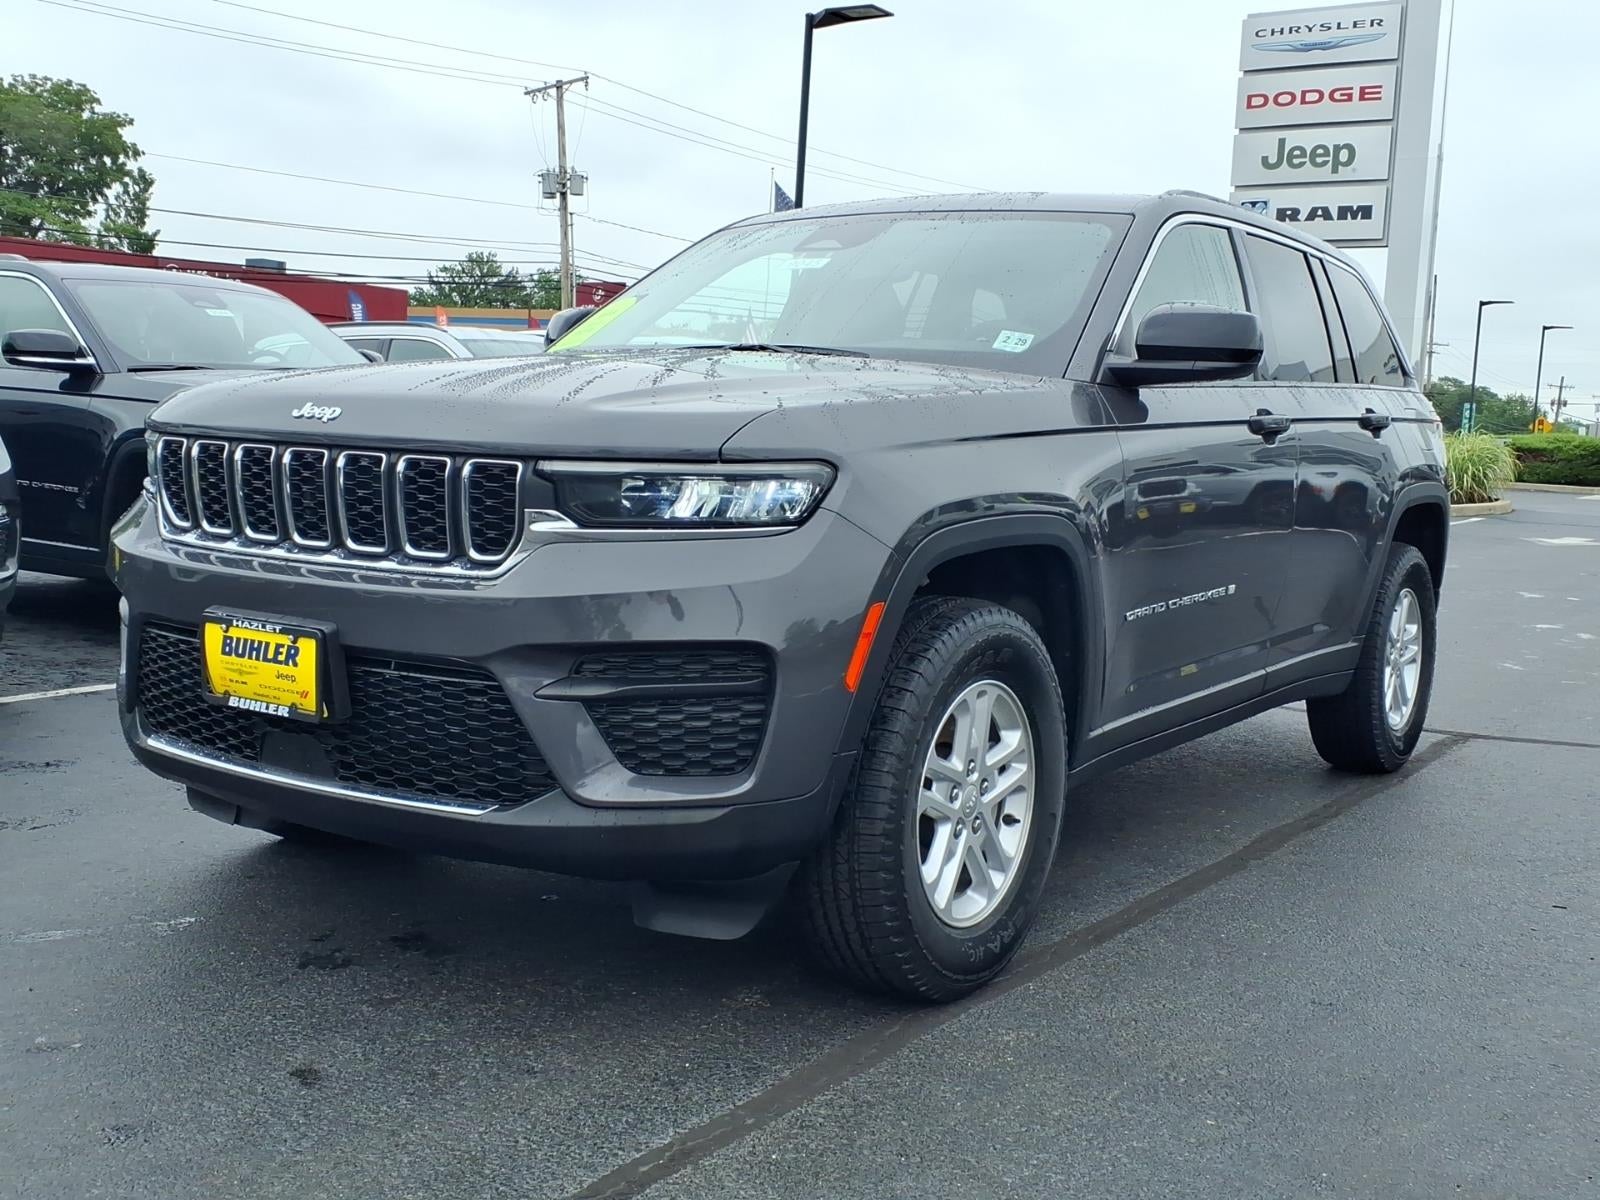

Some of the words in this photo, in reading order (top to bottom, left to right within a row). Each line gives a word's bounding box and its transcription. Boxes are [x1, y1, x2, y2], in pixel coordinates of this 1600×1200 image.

[1255, 18, 1385, 38] CHRYSLER
[1246, 85, 1383, 110] DODGE
[1261, 137, 1357, 174] Jeep
[1275, 204, 1374, 222] RAM
[291, 402, 342, 423] Jeep
[1126, 602, 1167, 621] GRAND
[1168, 587, 1226, 608] CHEROKEE
[233, 619, 282, 634] HAZLET
[221, 635, 300, 667] BUHLER
[274, 670, 297, 684] Jeep
[229, 697, 289, 717] BUHLER
